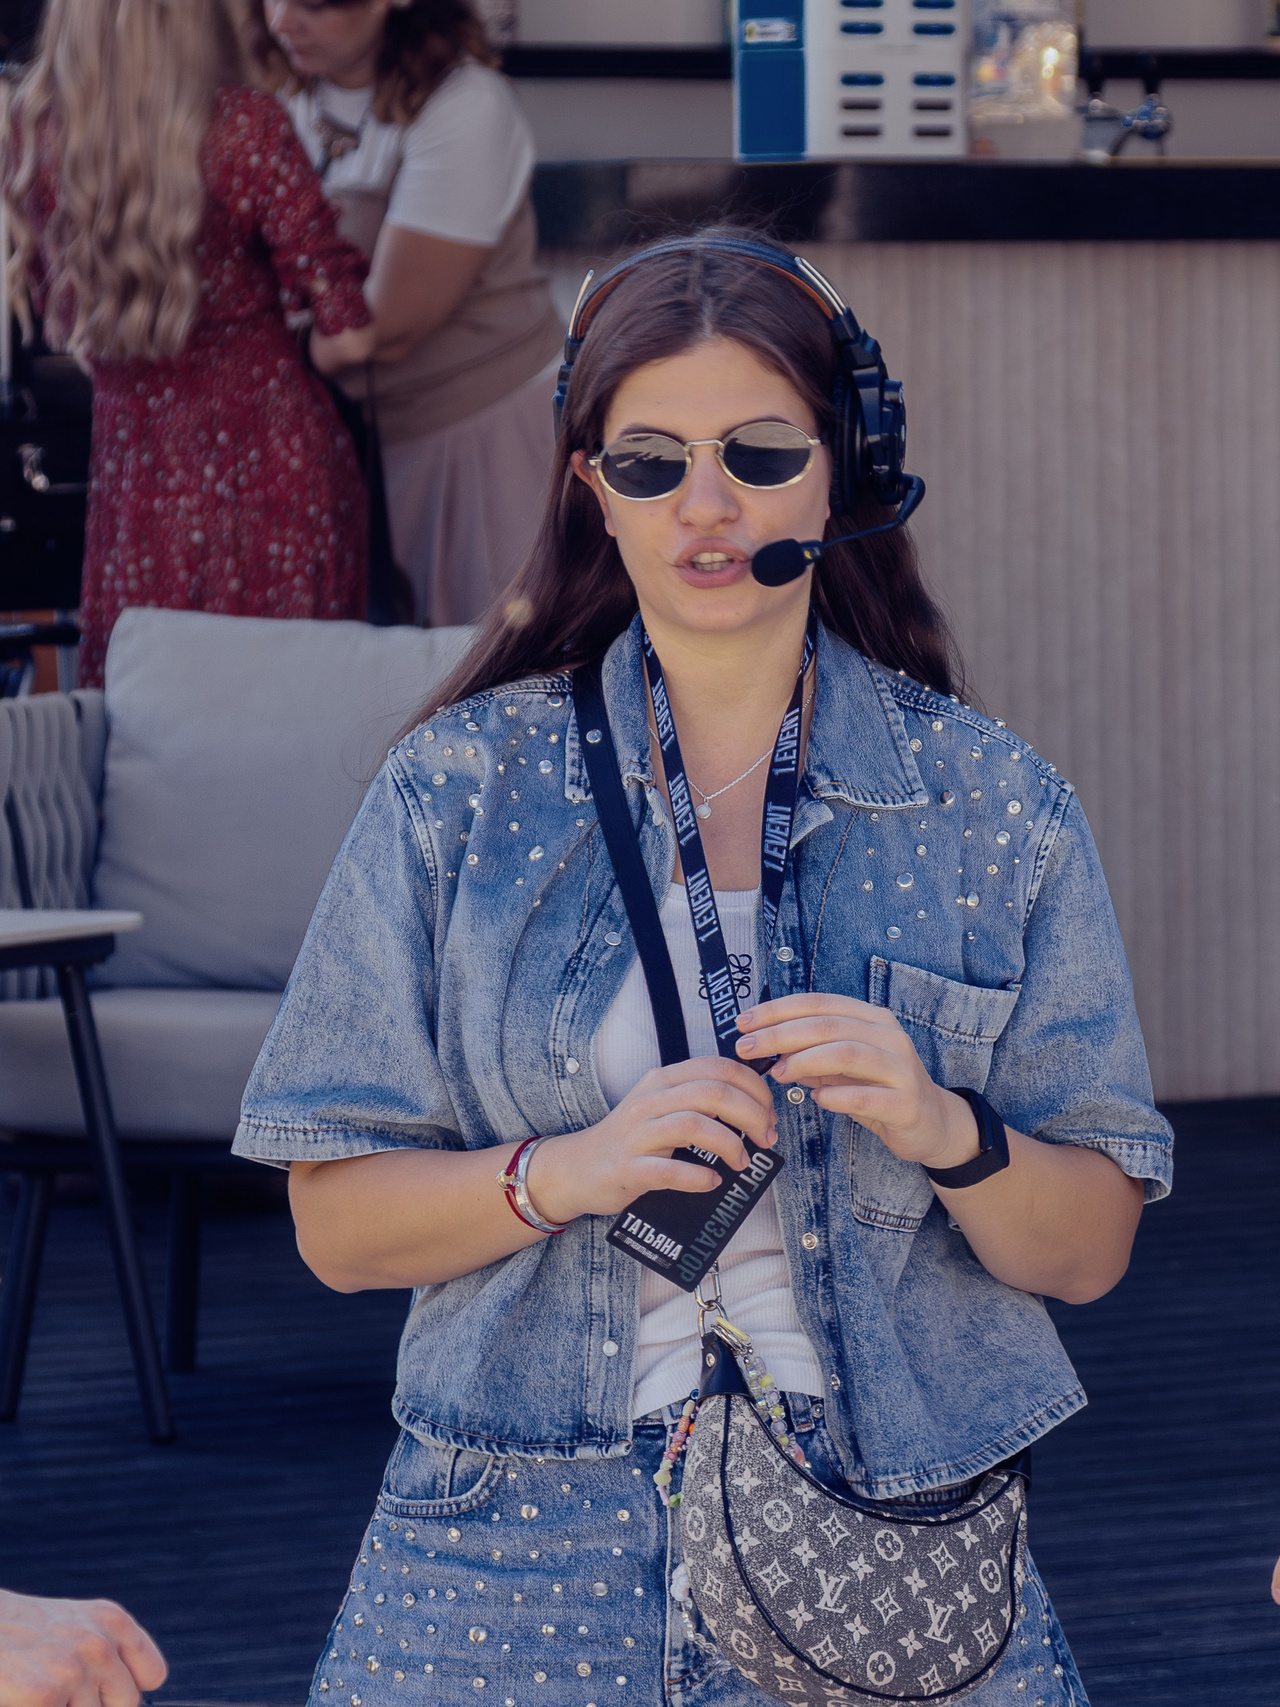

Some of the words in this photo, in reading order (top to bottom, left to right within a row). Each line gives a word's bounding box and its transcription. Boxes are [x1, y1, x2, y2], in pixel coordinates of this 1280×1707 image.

[651, 676, 675, 752] 1.EVENT
[772, 707, 800, 776] 1.EVENT
[668, 771, 698, 847] 1.EVENT
[763, 801, 792, 873] 1.EVENT
[685, 867, 719, 943] 1.EVENT
[706, 965, 740, 1040] 1.EVENT
[621, 1212, 684, 1261] ТАТЬЯНА
[676, 1151, 774, 1283] ОРГАНИЗАТОР
